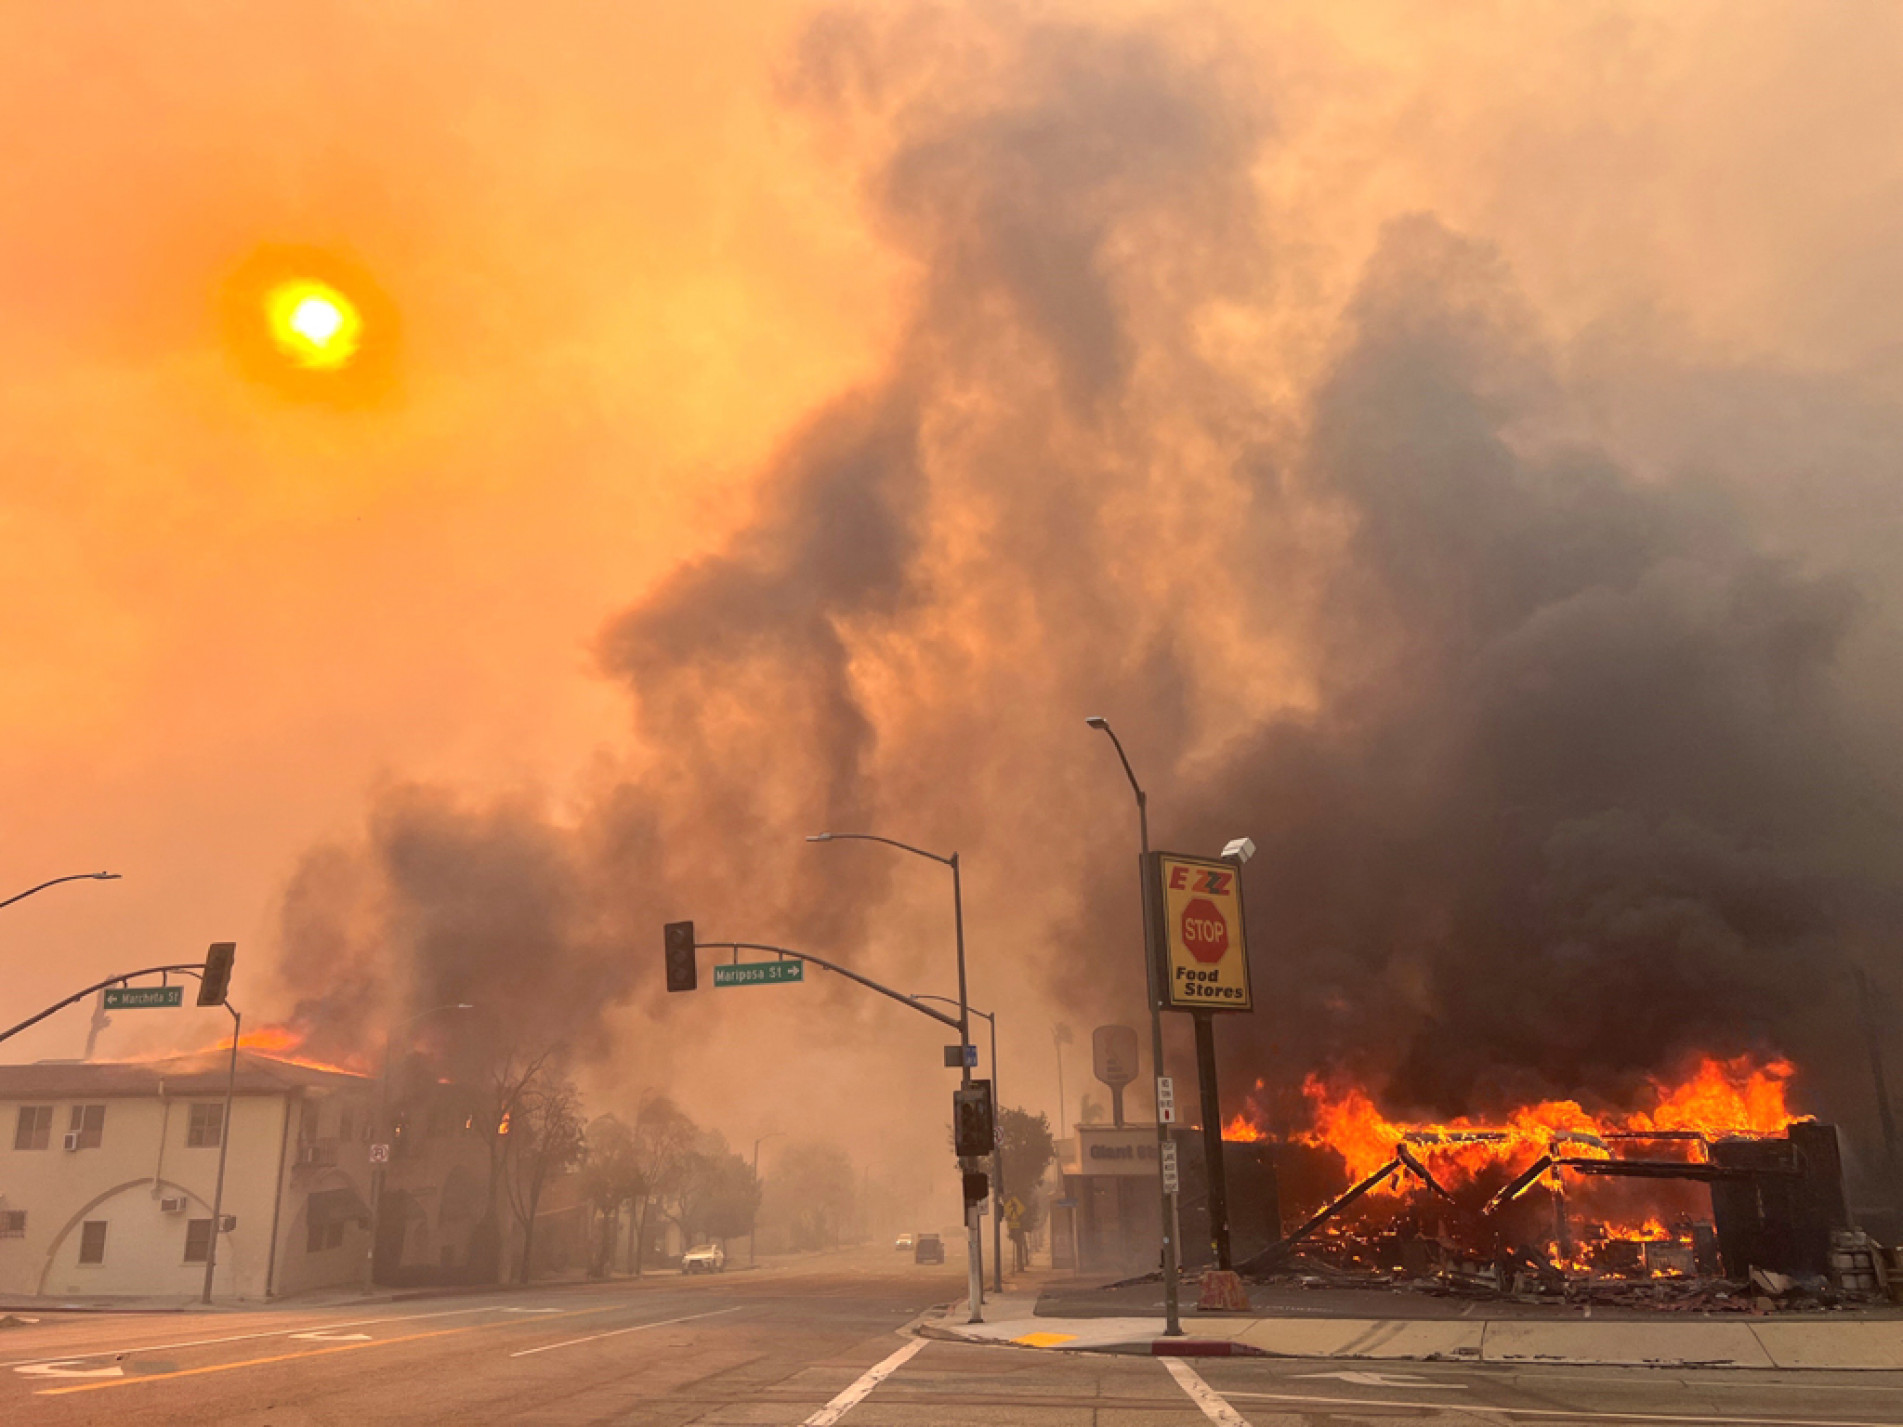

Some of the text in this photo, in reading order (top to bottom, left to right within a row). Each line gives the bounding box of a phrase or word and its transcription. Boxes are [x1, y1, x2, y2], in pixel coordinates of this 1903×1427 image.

[1185, 918, 1223, 943] STOP
[717, 966, 782, 982] Mariposa St
[1176, 965, 1219, 982] Food
[169, 991, 179, 1003] St
[1184, 982, 1243, 998] Stores
